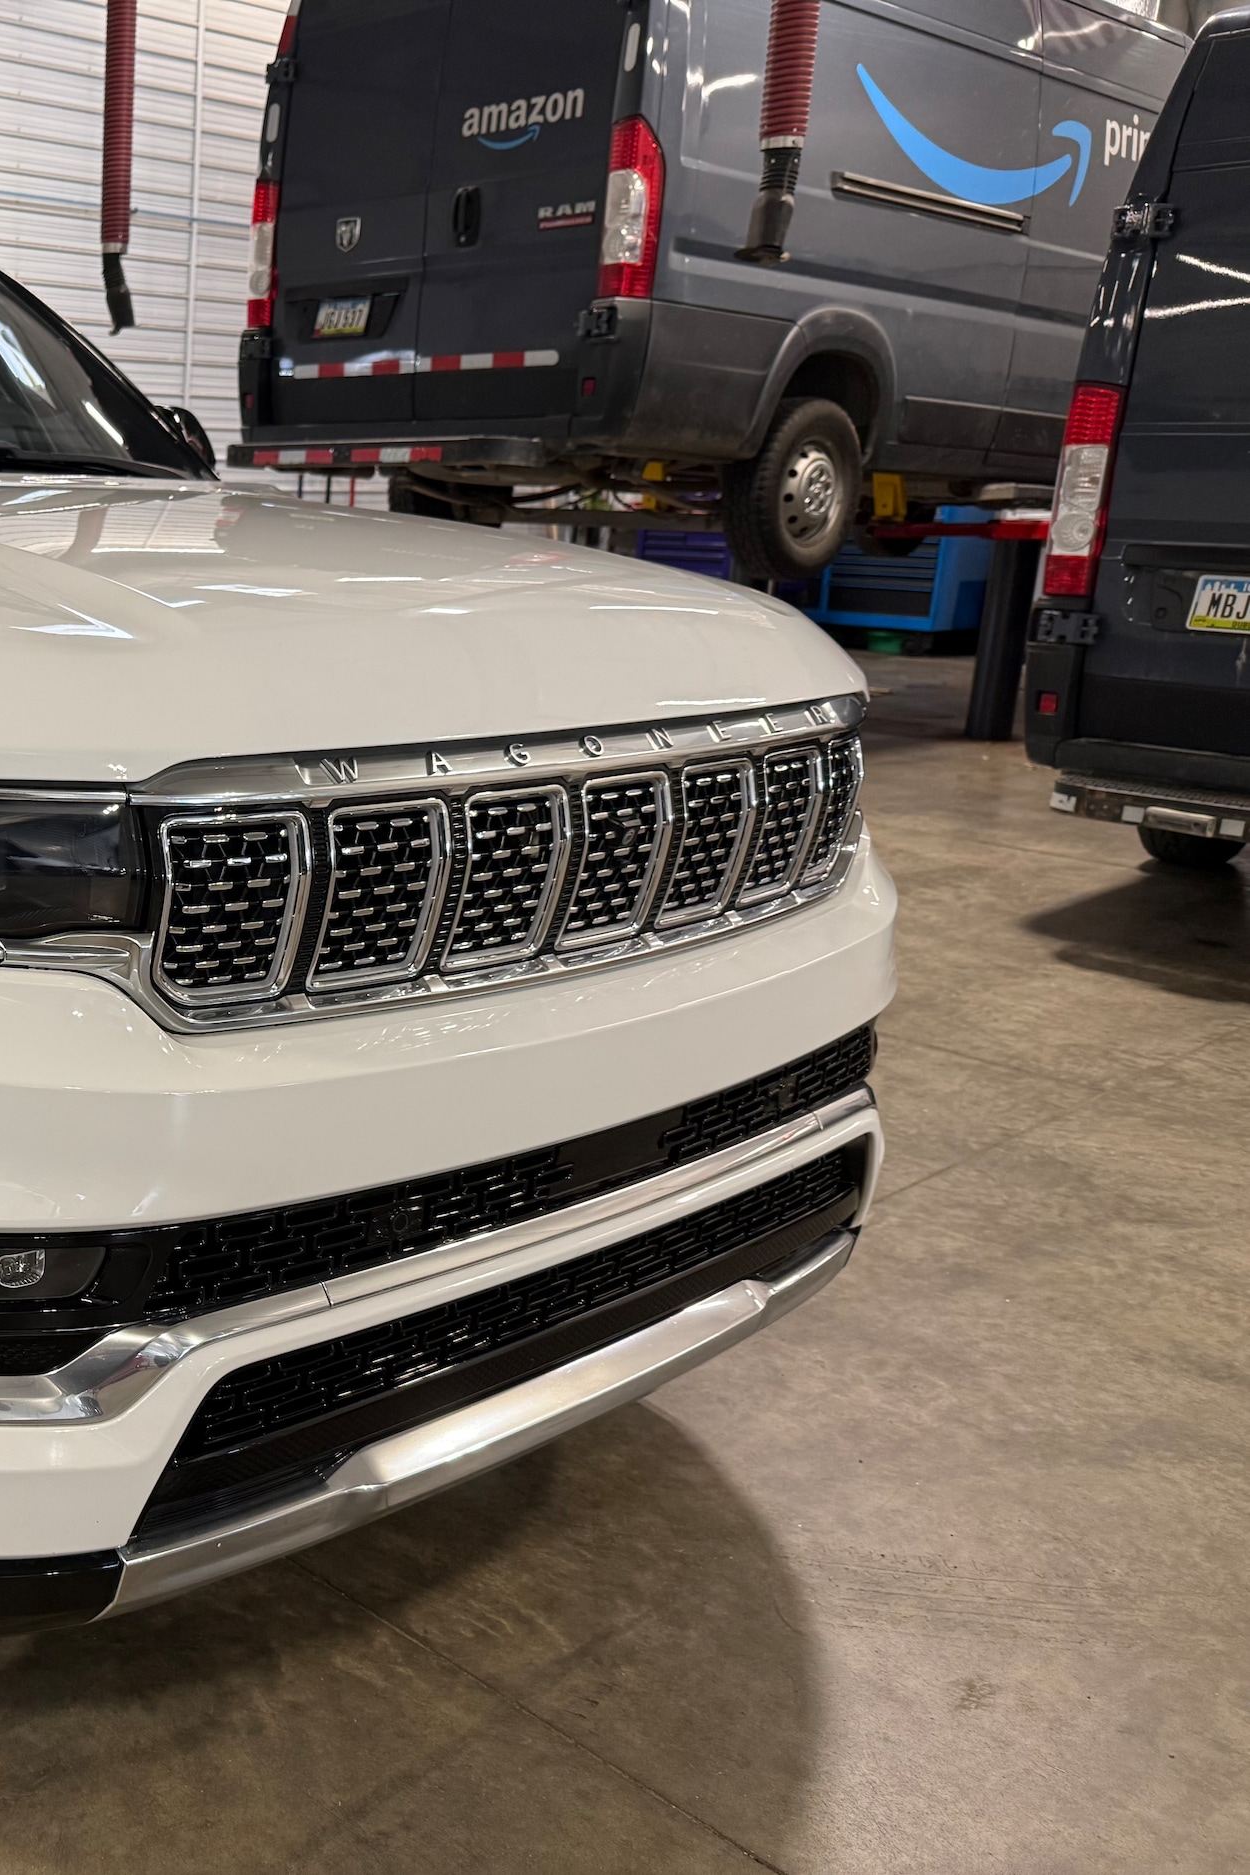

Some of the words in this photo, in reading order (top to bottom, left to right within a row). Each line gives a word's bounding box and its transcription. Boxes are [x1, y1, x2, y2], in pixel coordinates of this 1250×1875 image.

[461, 88, 585, 137] amazon
[537, 200, 596, 218] RAM
[1206, 592, 1250, 620] MBJ
[321, 704, 830, 784] WAGONEER
